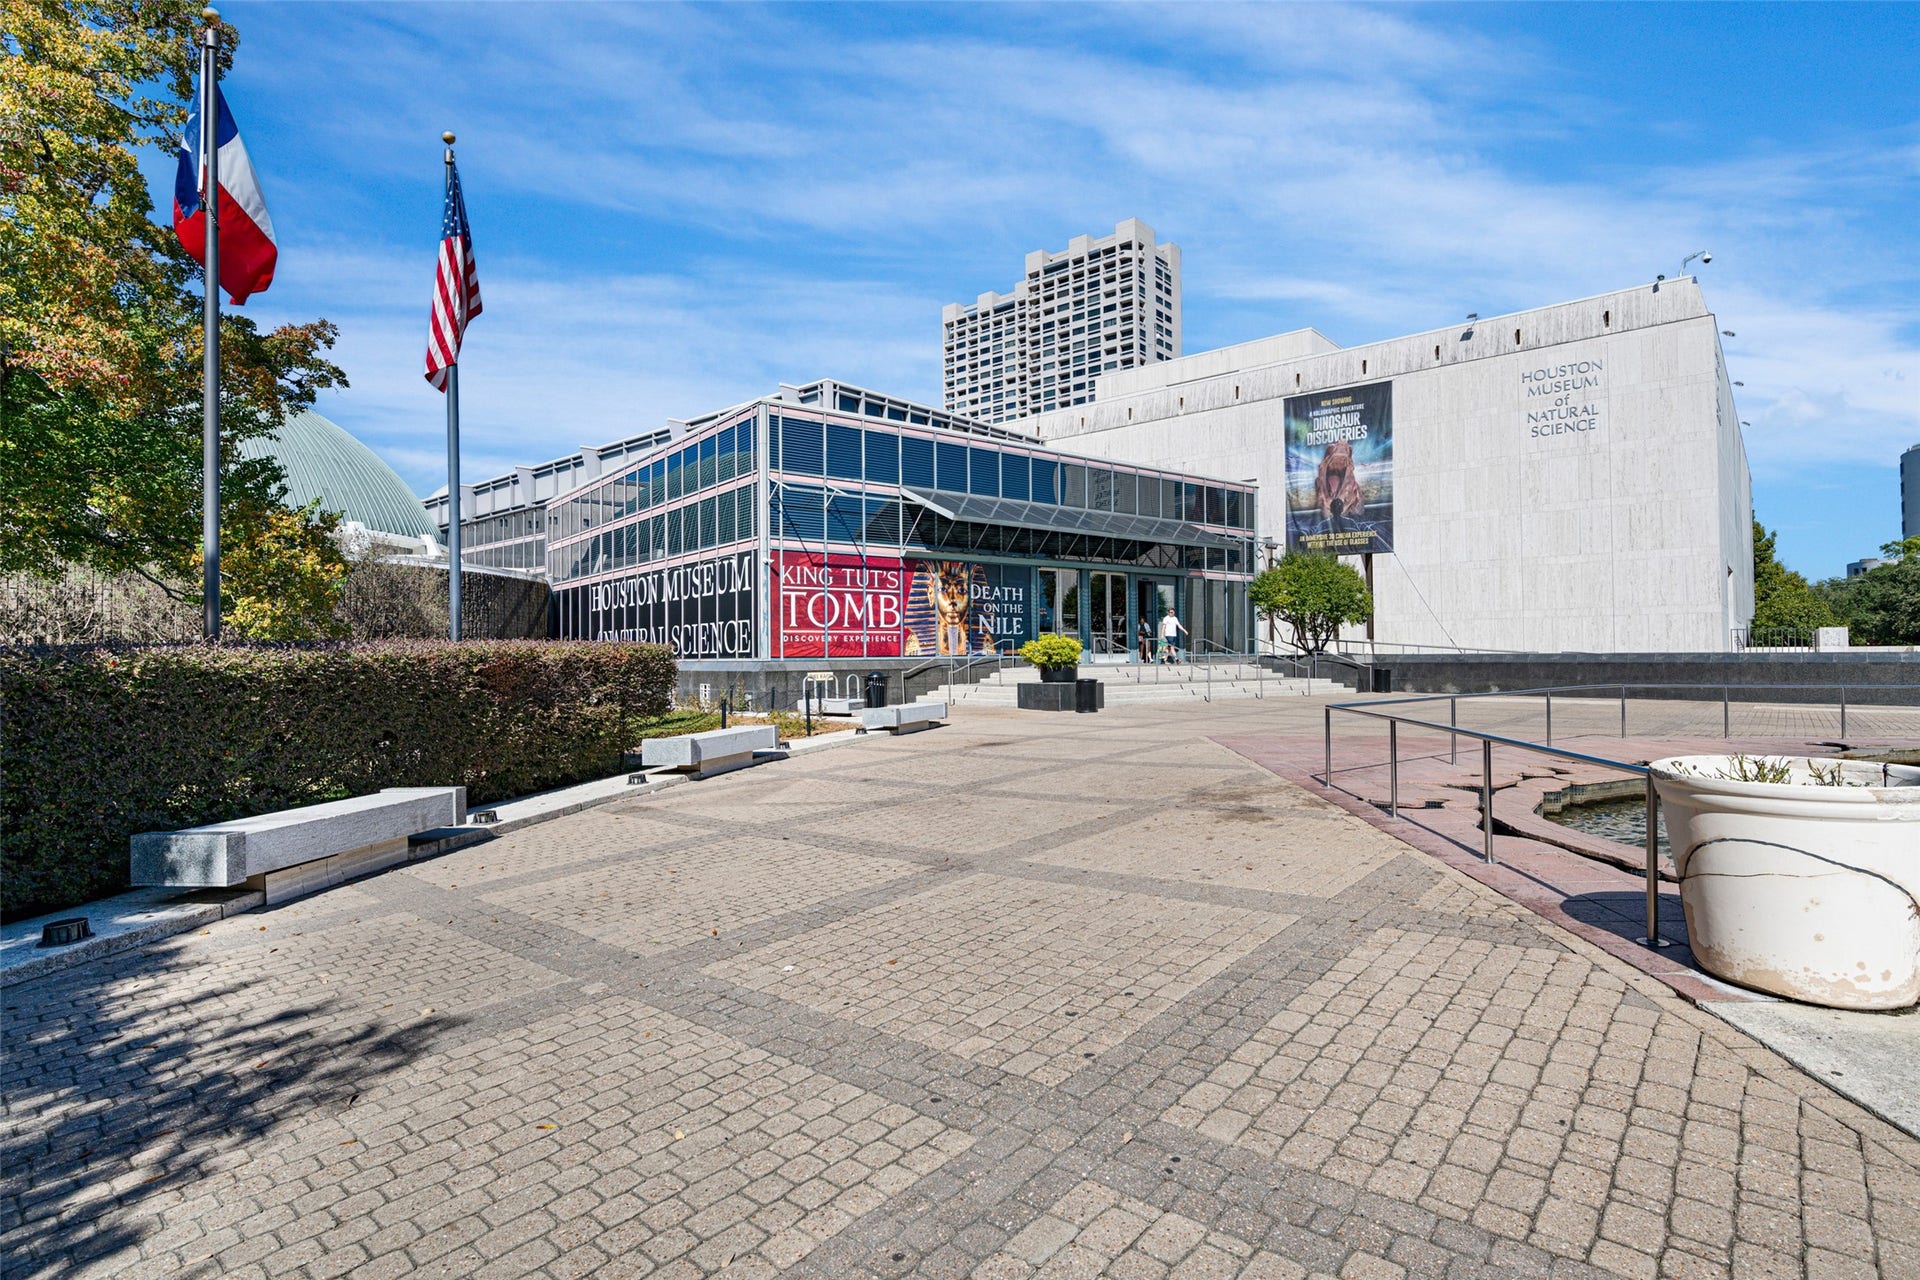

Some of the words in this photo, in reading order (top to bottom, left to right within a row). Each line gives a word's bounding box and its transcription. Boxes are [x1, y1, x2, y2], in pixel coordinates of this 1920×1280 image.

[1521, 359, 1603, 384] HOUSTON
[1527, 375, 1599, 398] MUSEUM
[1554, 393, 1570, 407] of
[1313, 412, 1360, 431] DINOSAUR
[1527, 404, 1599, 424] NATURAL
[1307, 425, 1368, 446] DISCOVERIES
[1531, 418, 1596, 438] SCIENCE
[592, 574, 659, 612] HOUSTON
[661, 555, 751, 603] MUSEUM
[782, 565, 833, 587] KING
[839, 568, 899, 589] TUT'S
[971, 584, 1023, 601] DEATH
[783, 591, 900, 629] TOMB
[983, 603, 1000, 613] ON
[1002, 603, 1023, 614] THE
[978, 614, 1024, 635] NILE
[671, 619, 751, 655] SCIENCE
[783, 634, 838, 643] DISCOVERY
[843, 635, 898, 643] EXPERIENCE
